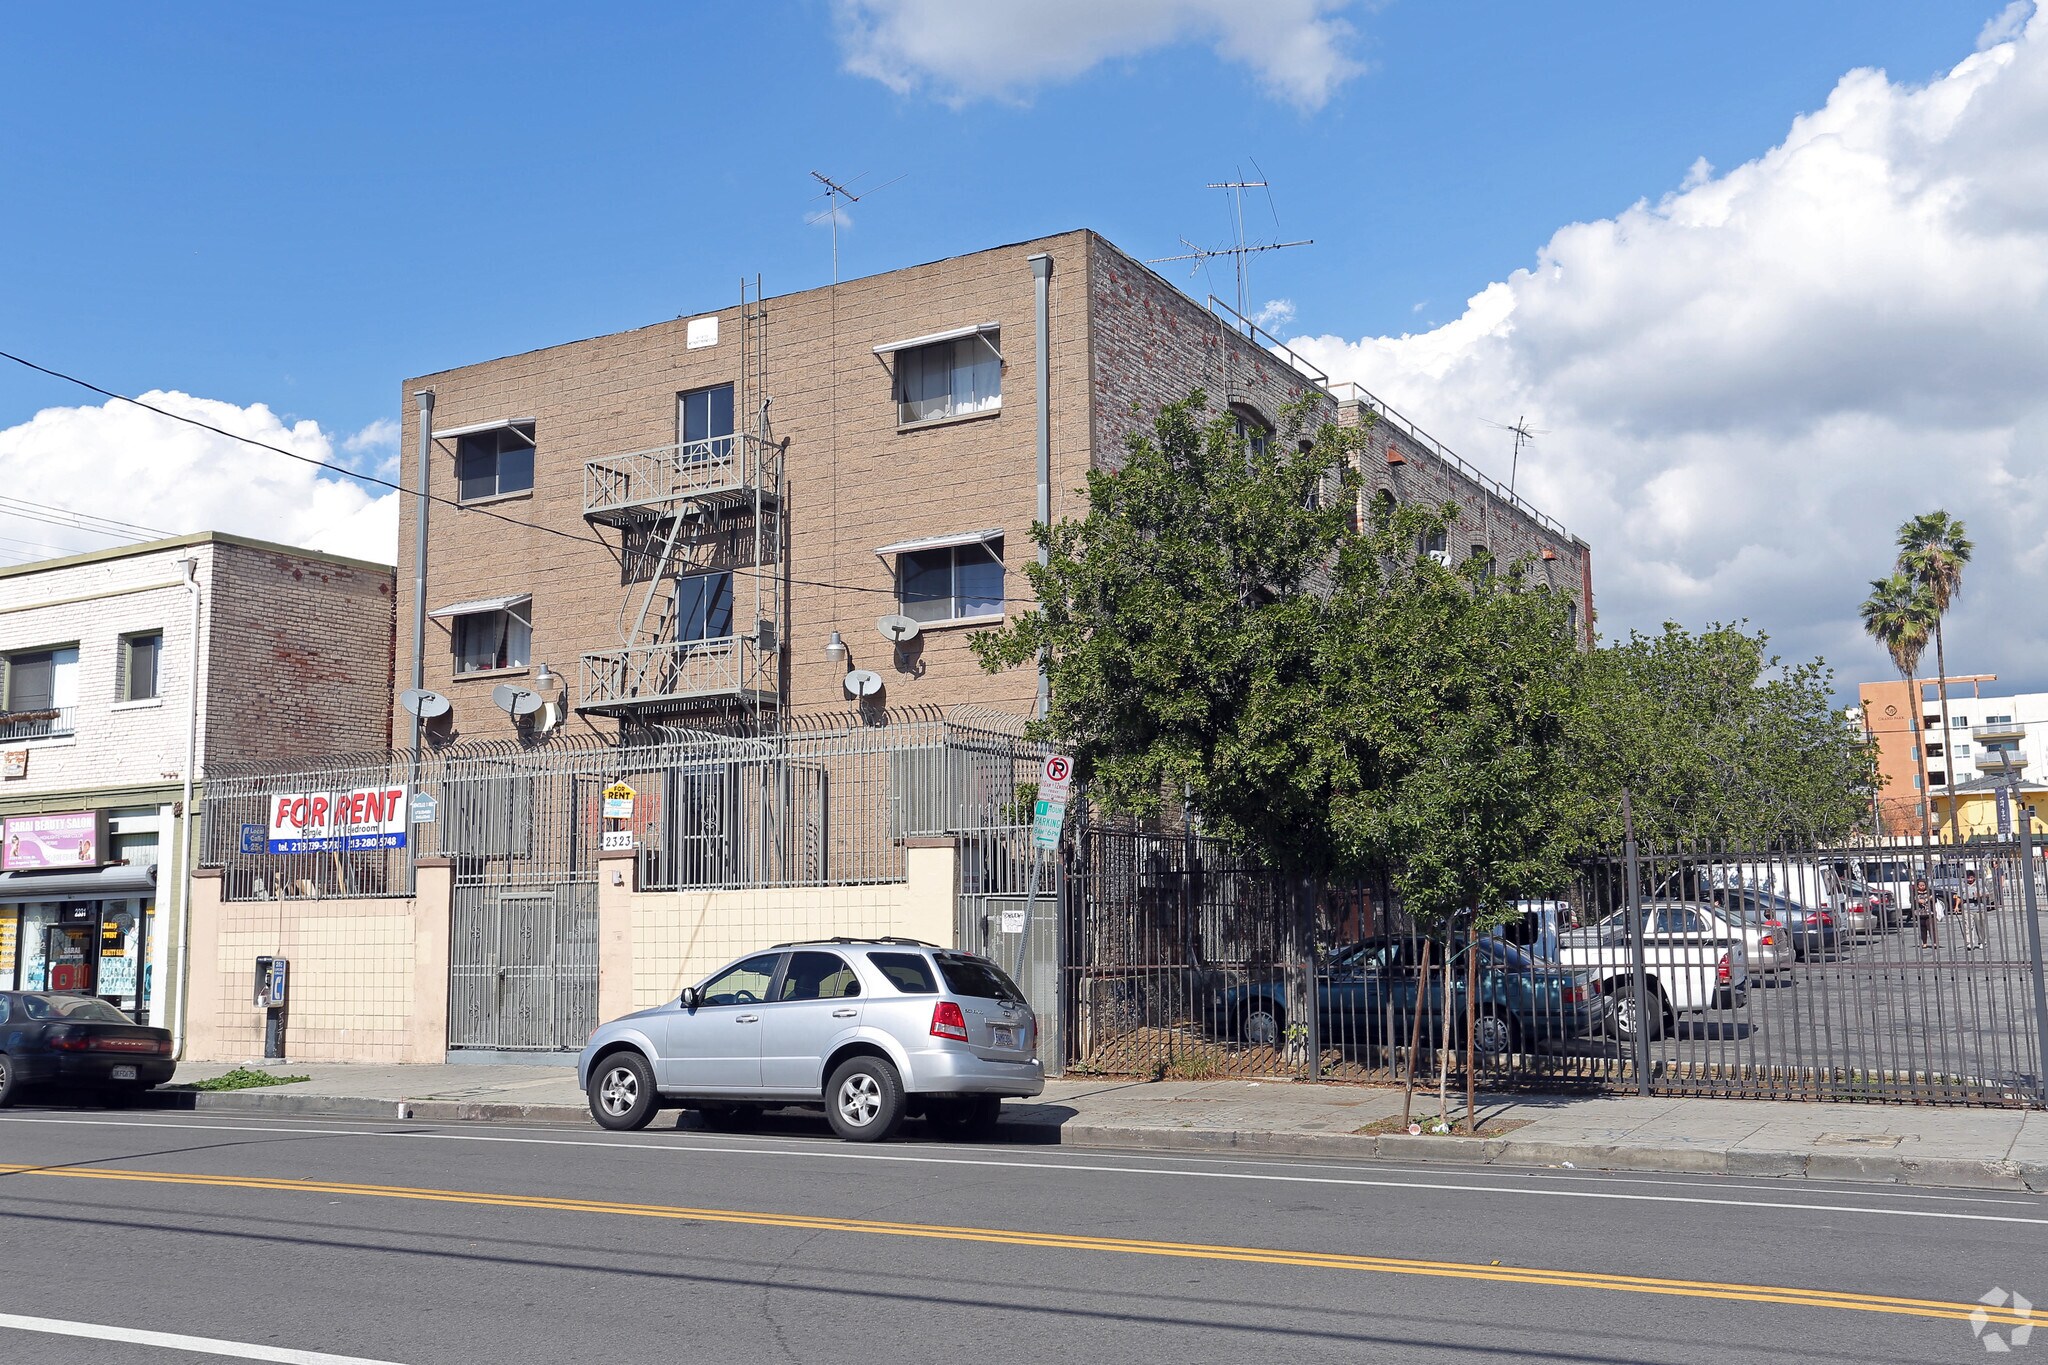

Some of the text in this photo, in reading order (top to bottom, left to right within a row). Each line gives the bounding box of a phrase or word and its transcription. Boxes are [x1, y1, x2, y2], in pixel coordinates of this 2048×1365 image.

[608, 792, 631, 800] RENT
[275, 790, 402, 828] FOR RENT
[1040, 803, 1063, 814] 1 HOUR
[9, 816, 92, 833] SARAI BEAUTY SALON
[1035, 816, 1061, 829] PARKING
[302, 828, 322, 838] Sngle
[1034, 827, 1059, 837] 8AM 6PM
[278, 842, 289, 852] tel.
[605, 836, 631, 847] 2323
